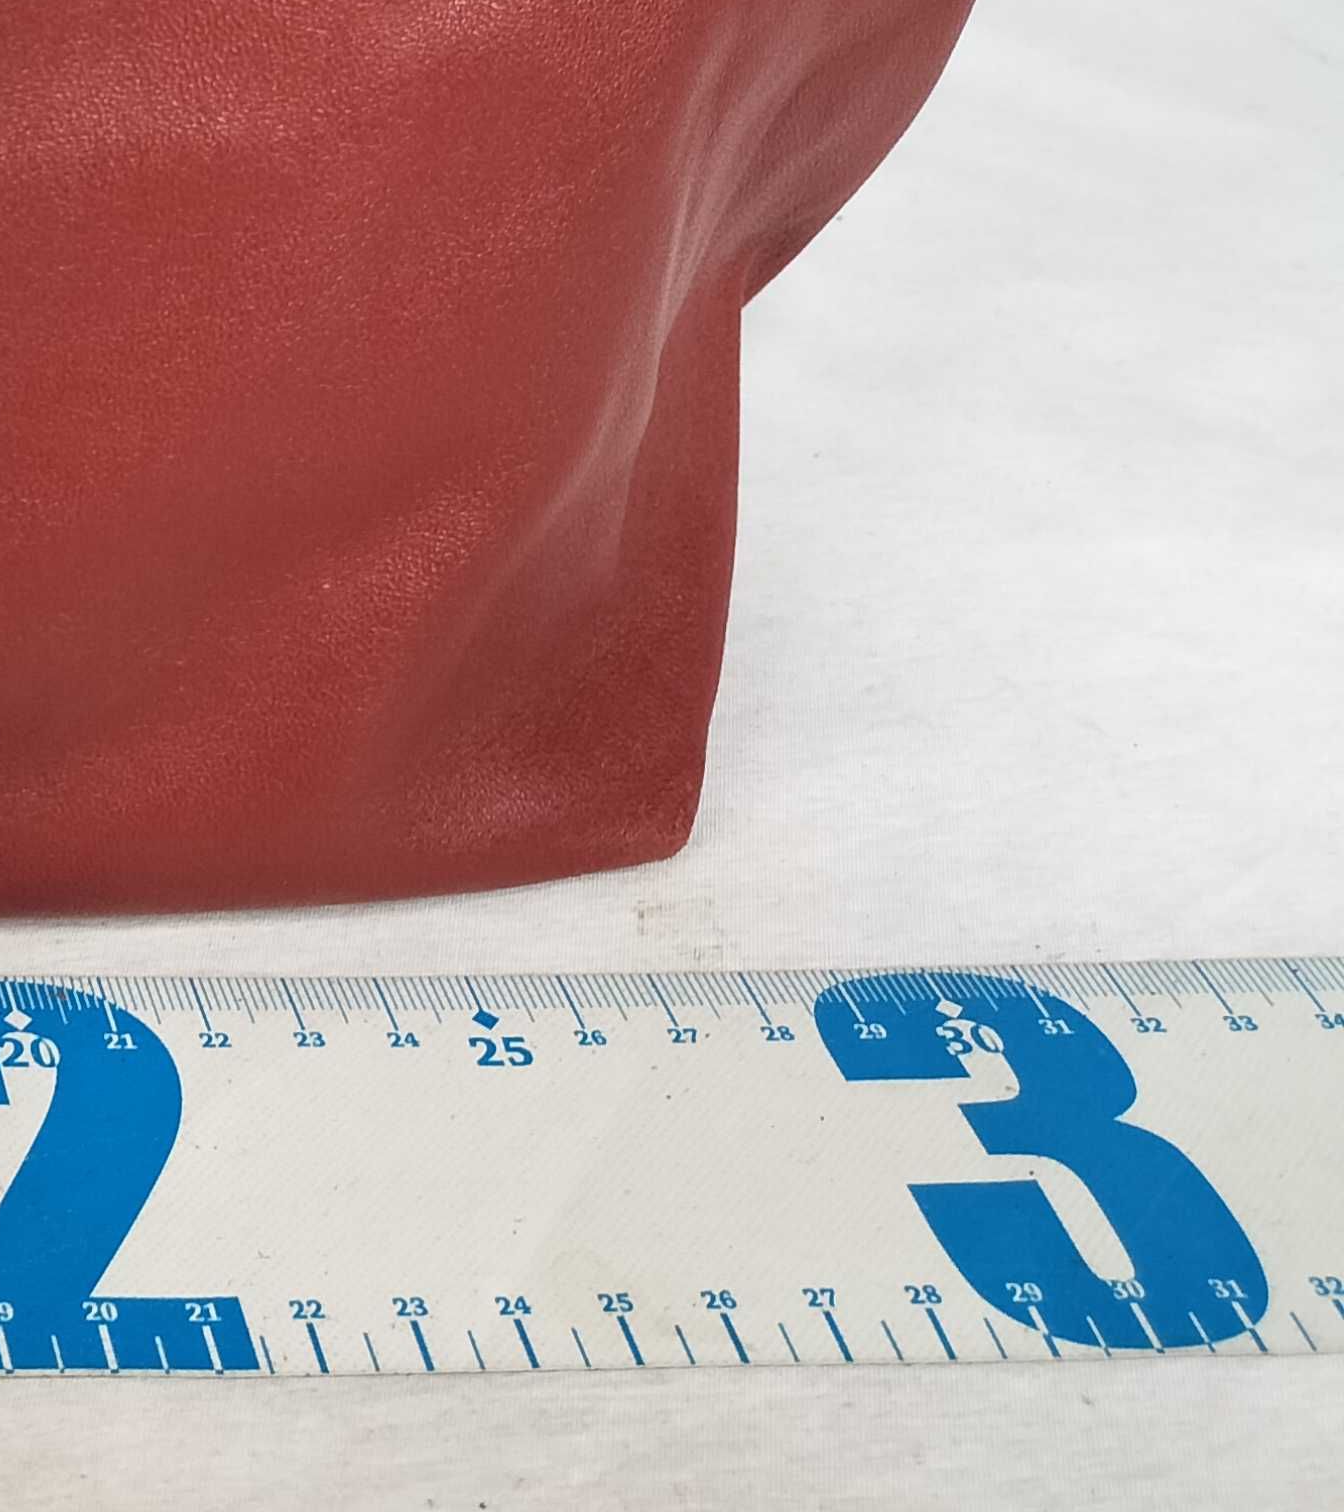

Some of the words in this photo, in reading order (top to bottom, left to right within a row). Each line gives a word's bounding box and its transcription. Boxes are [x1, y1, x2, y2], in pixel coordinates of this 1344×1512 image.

[103, 1033, 138, 1050] 21
[198, 1032, 233, 1049] 22
[293, 1031, 326, 1048] 23
[386, 1031, 421, 1048] 24
[468, 1037, 534, 1066] 25
[573, 1029, 608, 1046] 26
[666, 1026, 698, 1045] 27
[759, 1024, 796, 1042] 28
[852, 1023, 888, 1040] 29
[935, 1024, 1005, 1057] 30
[1036, 1019, 1076, 1036] 31
[1129, 1017, 1168, 1034] 32
[1221, 1015, 1260, 1032] 33
[1313, 1013, 1344, 1030] 34
[813, 972, 1269, 1350] 3
[82, 1302, 118, 1323] 20
[185, 1302, 222, 1323] 21
[288, 1299, 327, 1320] 22
[392, 1297, 429, 1318] 23
[493, 1296, 532, 1317] 24
[597, 1292, 635, 1313] 25
[700, 1289, 737, 1311] 26
[801, 1288, 837, 1310] 27
[904, 1285, 943, 1306] 28
[1005, 1282, 1043, 1304] 29
[1109, 1279, 1146, 1300] 30
[1207, 1278, 1248, 1300] 31
[1309, 1277, 1344, 1298] 32
